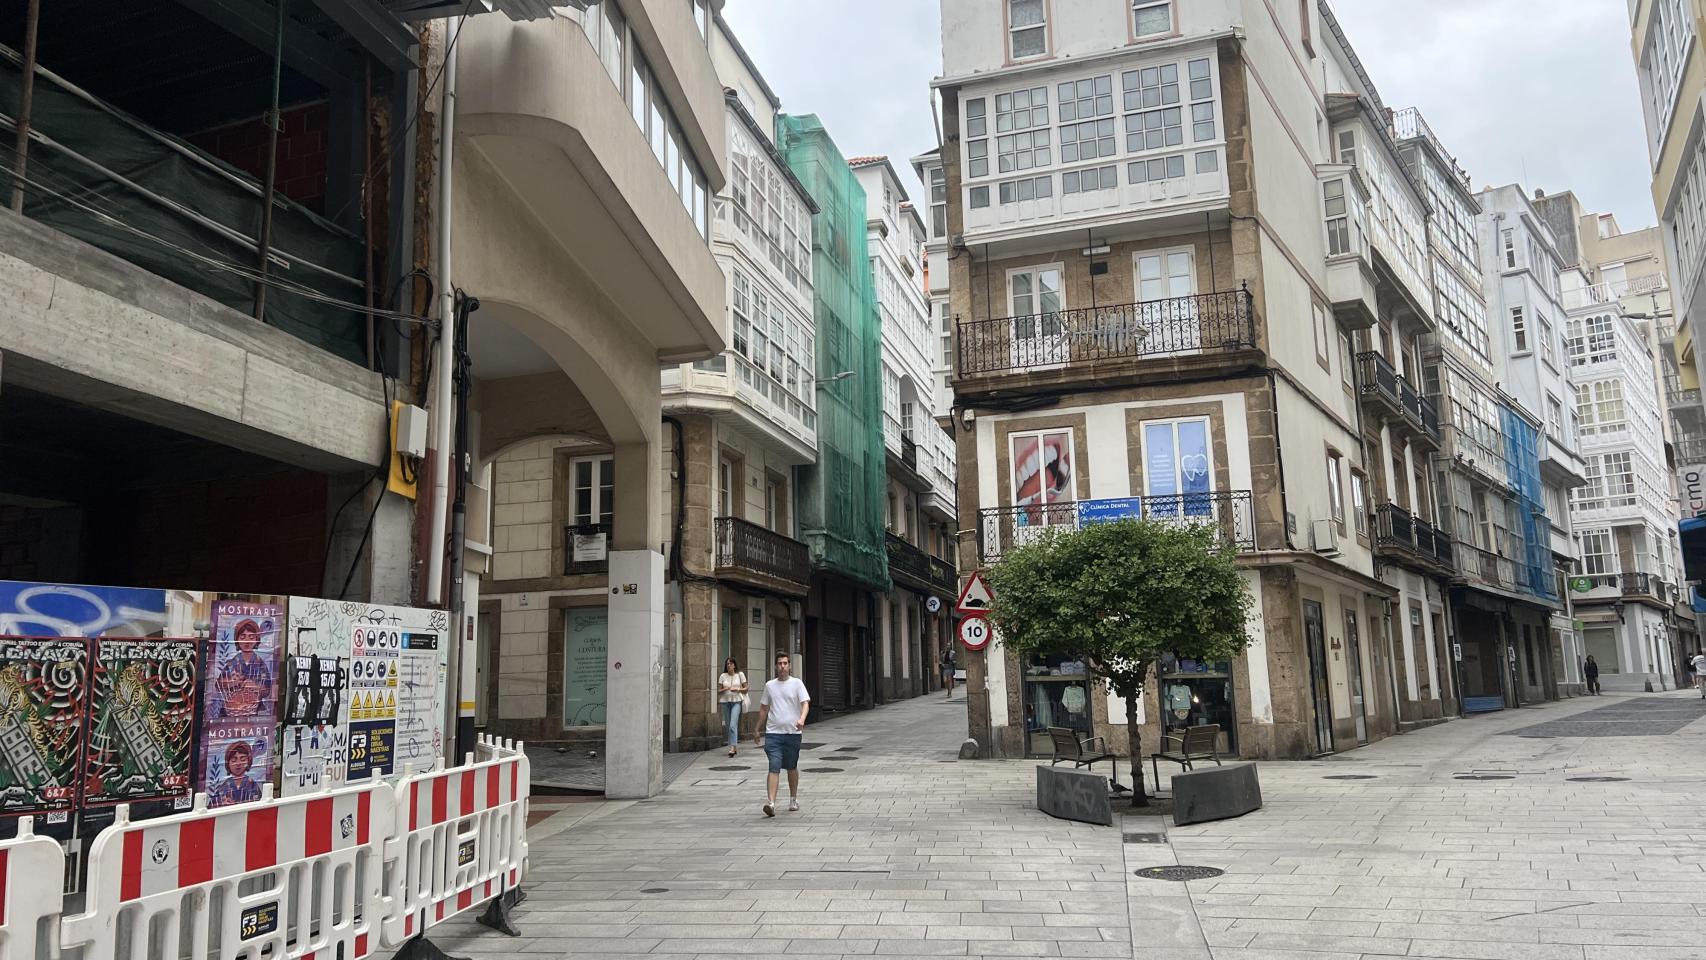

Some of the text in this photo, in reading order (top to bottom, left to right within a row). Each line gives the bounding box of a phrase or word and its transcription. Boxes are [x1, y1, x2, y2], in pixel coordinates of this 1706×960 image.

[218, 605, 277, 617] MOSTRART
[967, 626, 983, 637] 10
[298, 671, 310, 686] 15/8
[320, 673, 336, 688] 15/8
[208, 726, 269, 739] MOSTRART
[351, 734, 367, 748] F3
[164, 776, 181, 785] 6&7
[46, 788, 66, 798] 6&7
[243, 914, 258, 929] F3
